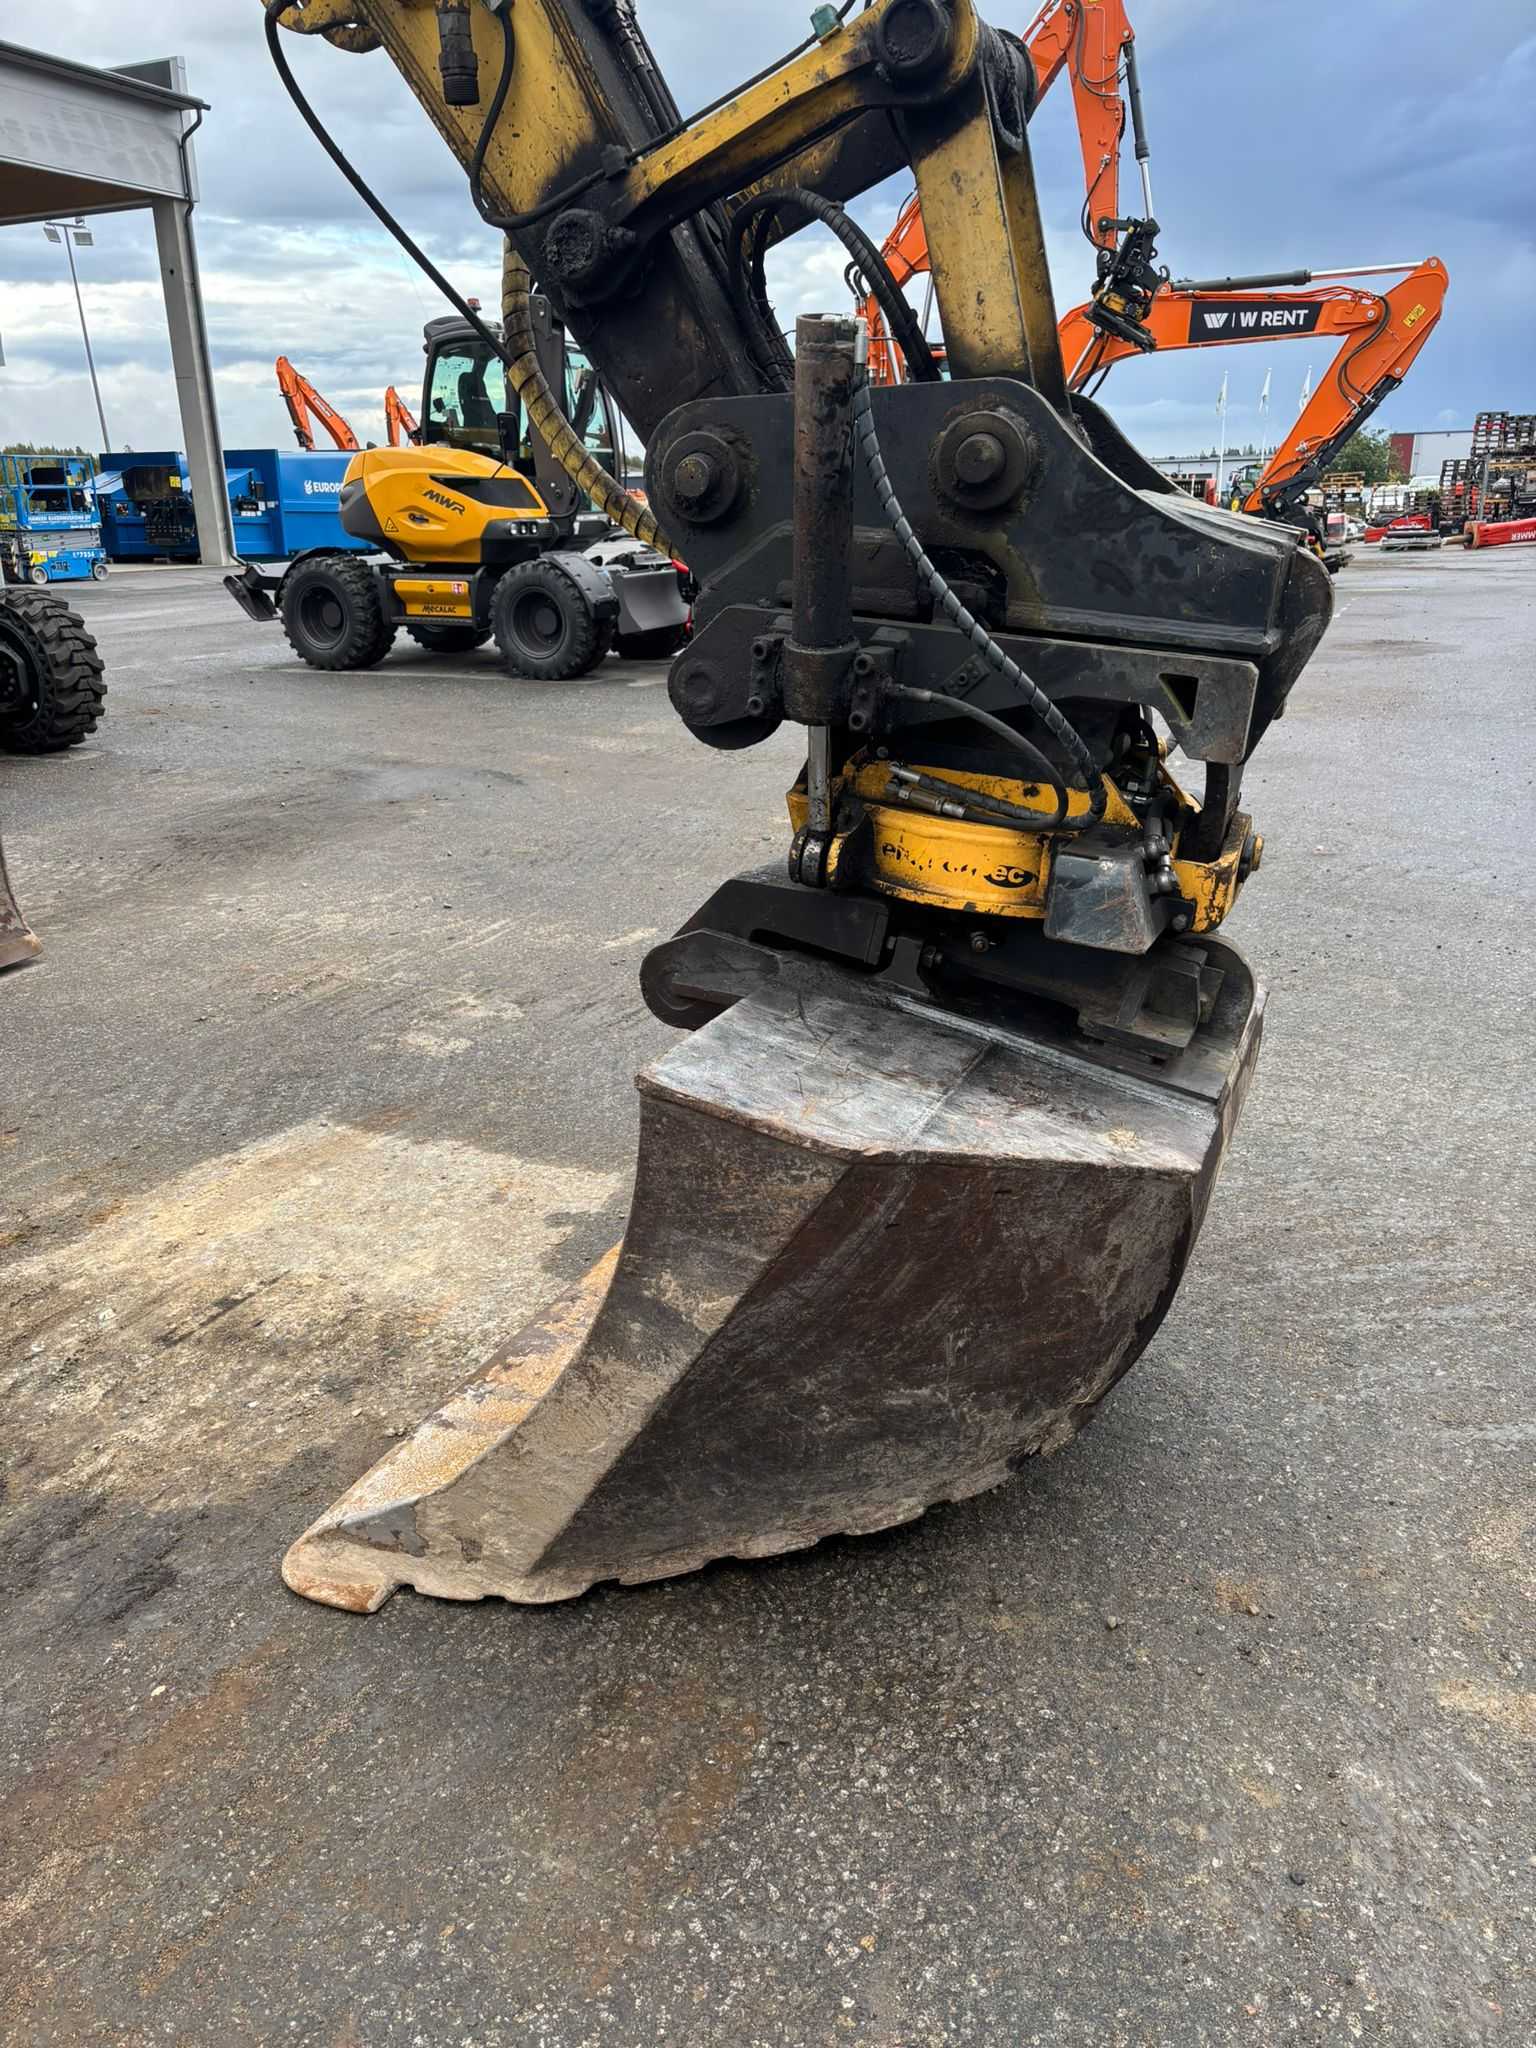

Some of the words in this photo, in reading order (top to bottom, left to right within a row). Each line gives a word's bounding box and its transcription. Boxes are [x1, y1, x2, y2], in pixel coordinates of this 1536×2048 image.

[1240, 311, 1258, 328] W
[1260, 309, 1309, 327] RENT
[422, 489, 465, 516] MWR
